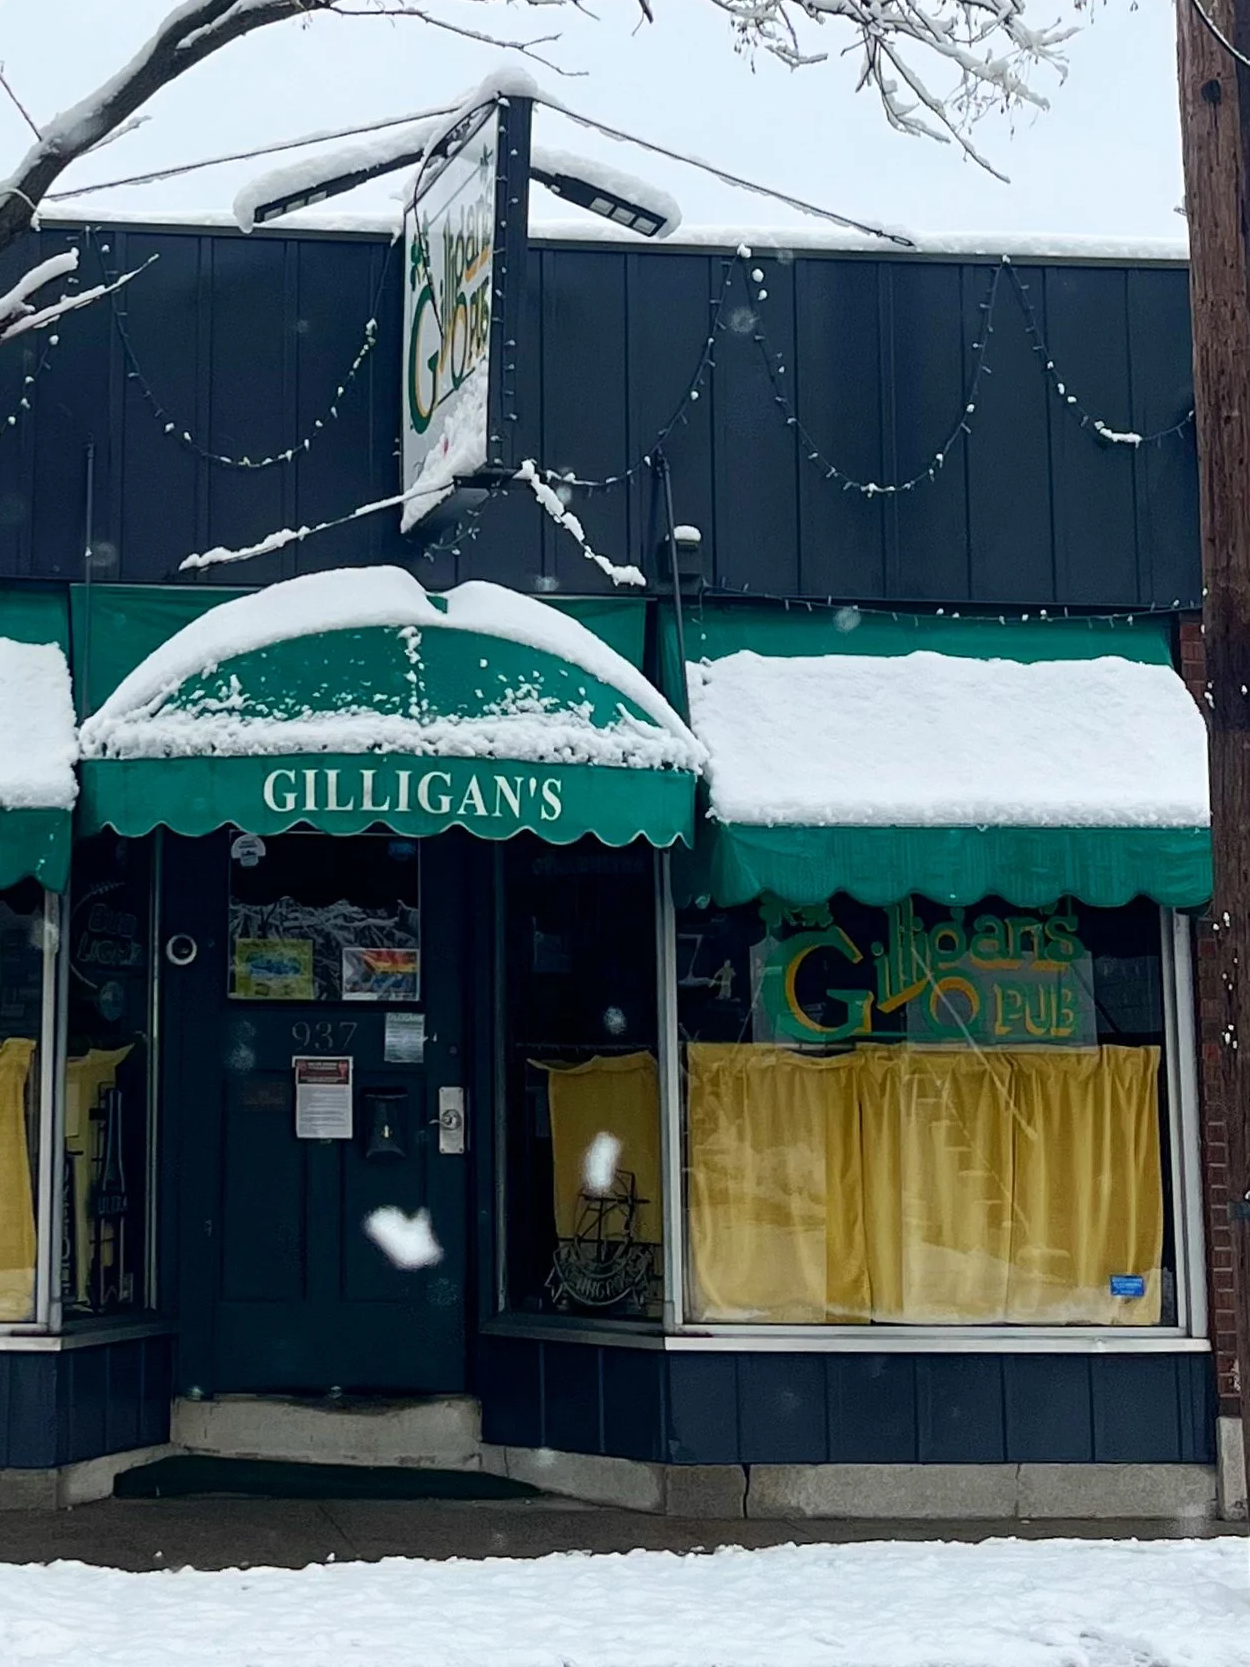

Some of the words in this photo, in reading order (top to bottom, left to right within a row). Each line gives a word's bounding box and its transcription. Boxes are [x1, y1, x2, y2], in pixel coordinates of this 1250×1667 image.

[263, 768, 563, 821] GILLIGAN'S
[291, 1021, 358, 1052] 937
[992, 982, 1078, 1038] PUB
